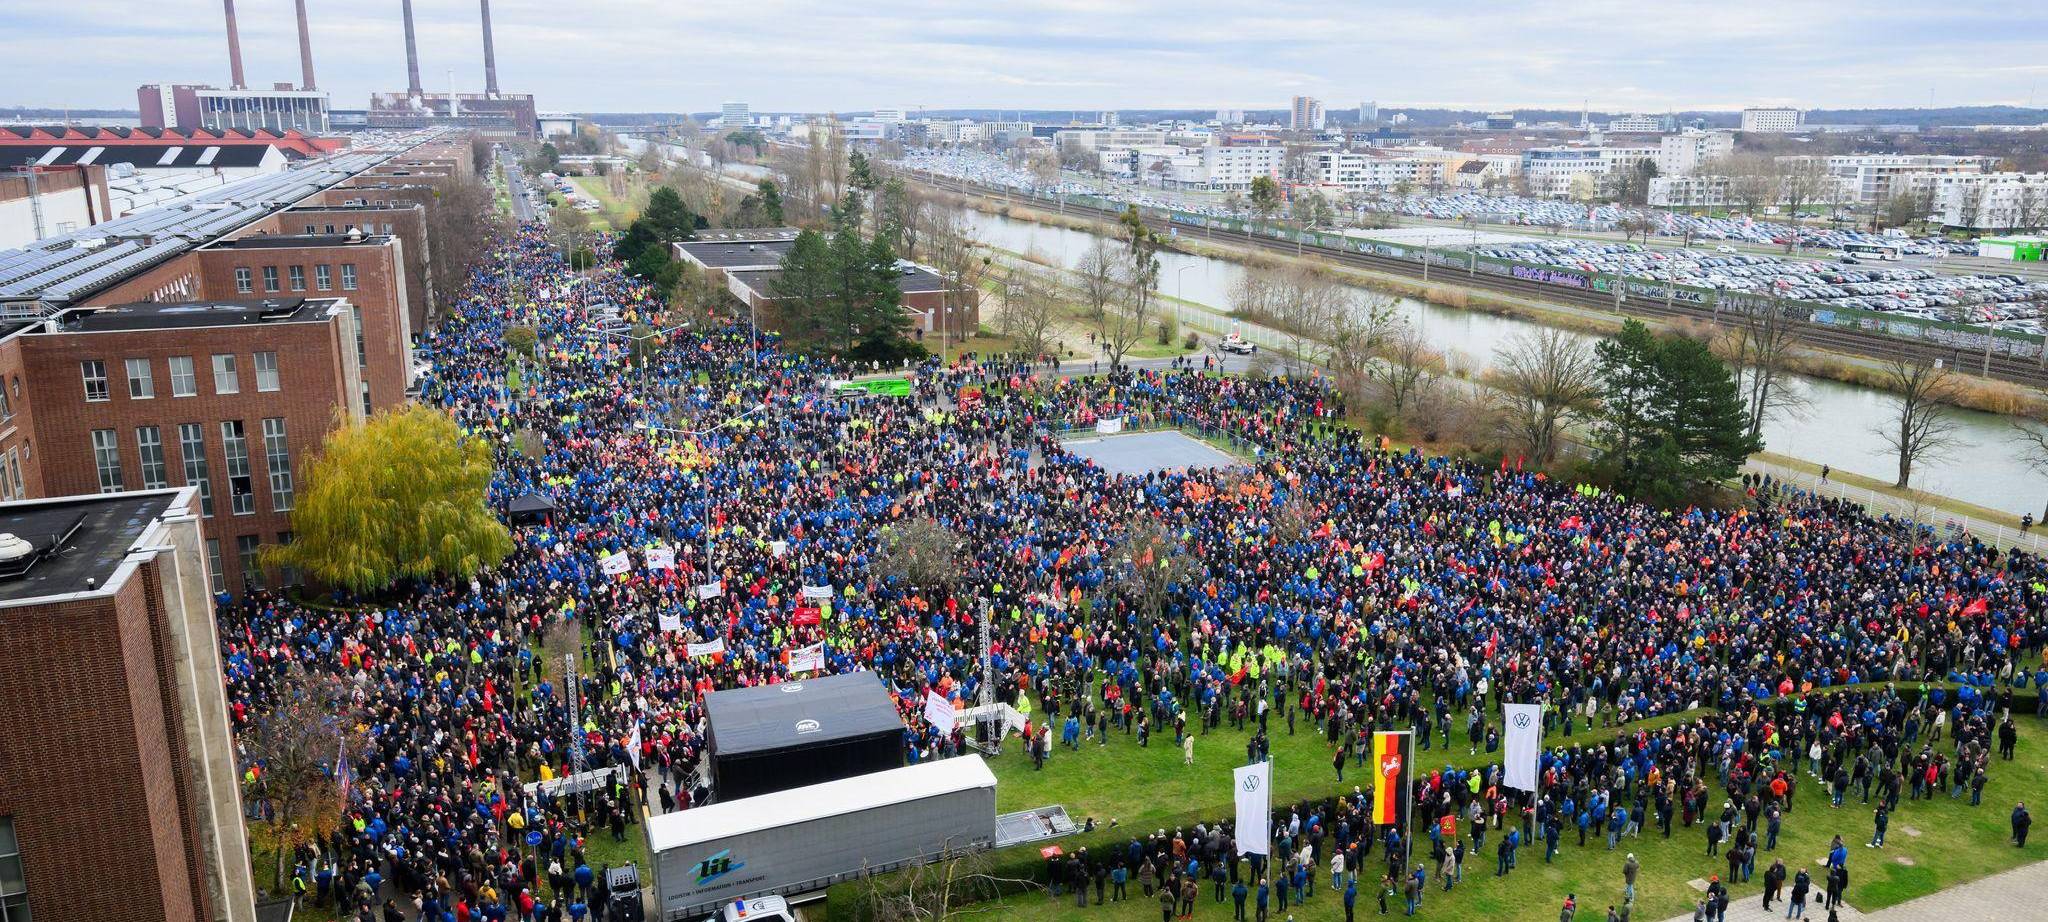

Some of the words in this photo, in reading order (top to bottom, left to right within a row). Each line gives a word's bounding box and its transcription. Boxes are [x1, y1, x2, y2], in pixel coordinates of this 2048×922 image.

[700, 856, 731, 878] lit
[696, 883, 732, 895] INFORMATION
[736, 875, 765, 886] TRANSPORT
